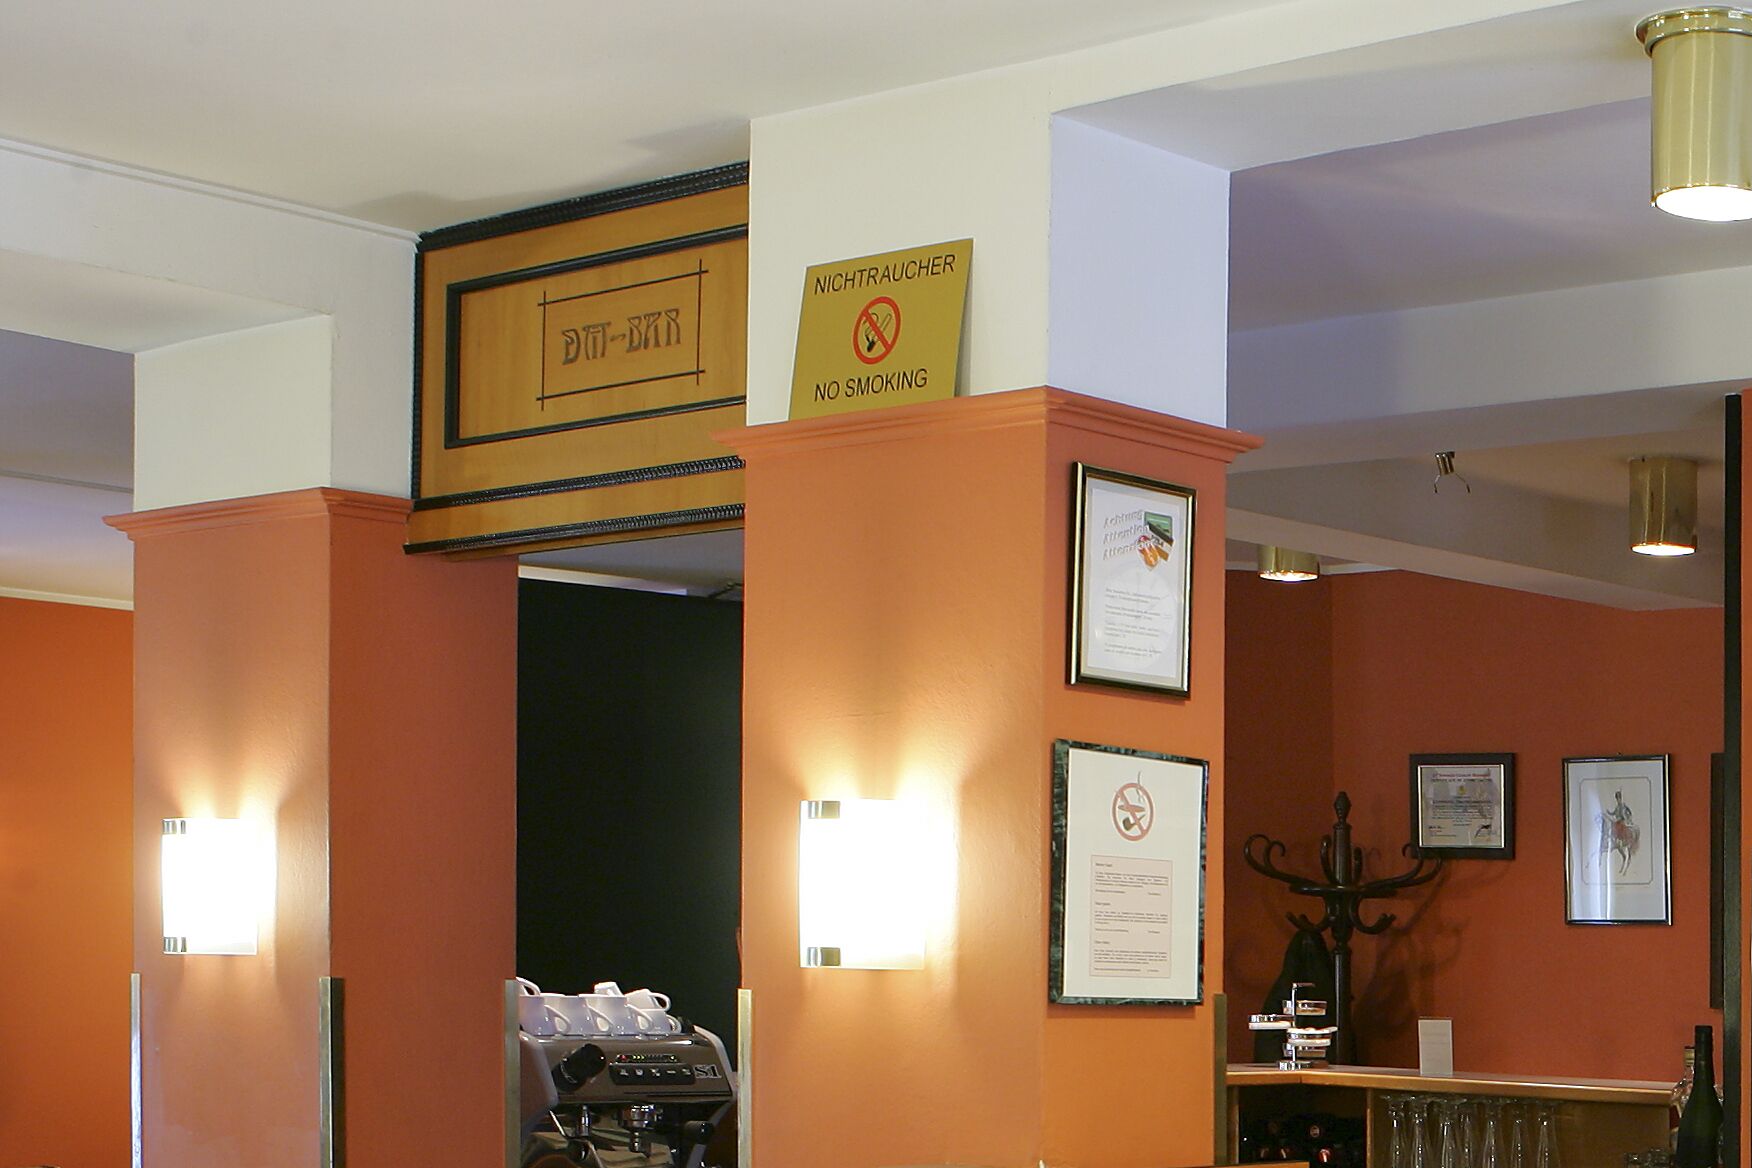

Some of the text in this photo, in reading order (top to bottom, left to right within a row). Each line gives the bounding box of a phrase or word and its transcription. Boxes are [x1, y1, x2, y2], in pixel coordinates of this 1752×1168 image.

[814, 254, 955, 295] NICHTRAUCHER
[814, 368, 928, 402] NO SMOKING
